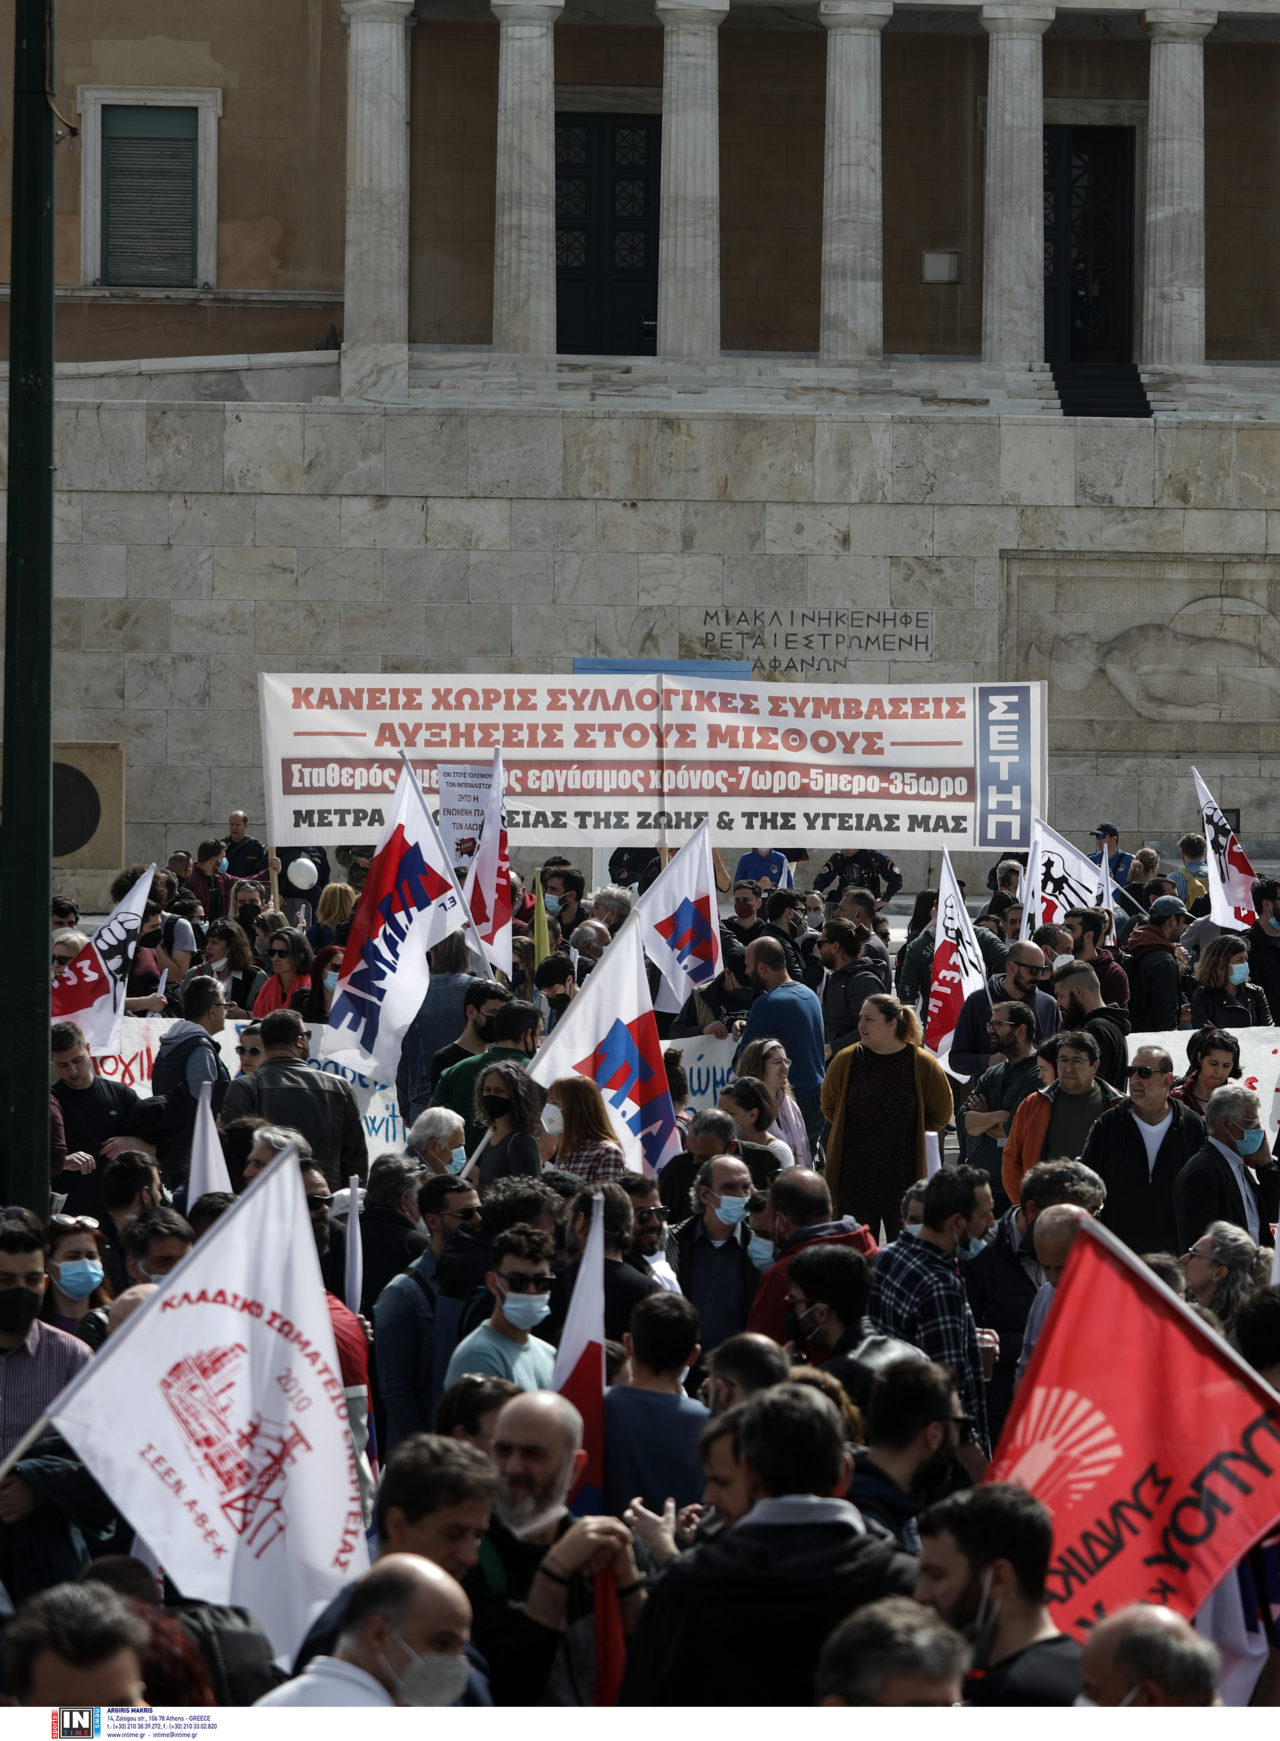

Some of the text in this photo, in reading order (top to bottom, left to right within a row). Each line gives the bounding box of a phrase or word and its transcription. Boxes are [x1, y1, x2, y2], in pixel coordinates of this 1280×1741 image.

[291, 687, 966, 720] ΚΑΝΕΙΣ ΧΩΡΙΣ ΣΥΛΛΟΓΙΚΕΣ ΣΥΜΒΑΣΕΙΣ
[374, 723, 885, 755] ΑΥΞΗΣΕΙΣ ΣΤΟΥΣ ΜΙΣΘΟΥΣ
[291, 763, 396, 791] Σταθερός
[527, 763, 645, 793] εργάσιμος
[987, 695, 1021, 840] ΣΕΤΗΠ
[293, 808, 385, 828] ΜΕΤΡΑ
[574, 810, 631, 830] ΤΗΣ
[637, 810, 709, 830] ΖΩΗΣ
[716, 810, 736, 831] &
[741, 811, 796, 831] ΤΗΣ
[803, 812, 903, 832] ΥΓΕΙΑΣ
[907, 814, 968, 834] ΜΑΣ
[275, 1367, 313, 1413] 2010
